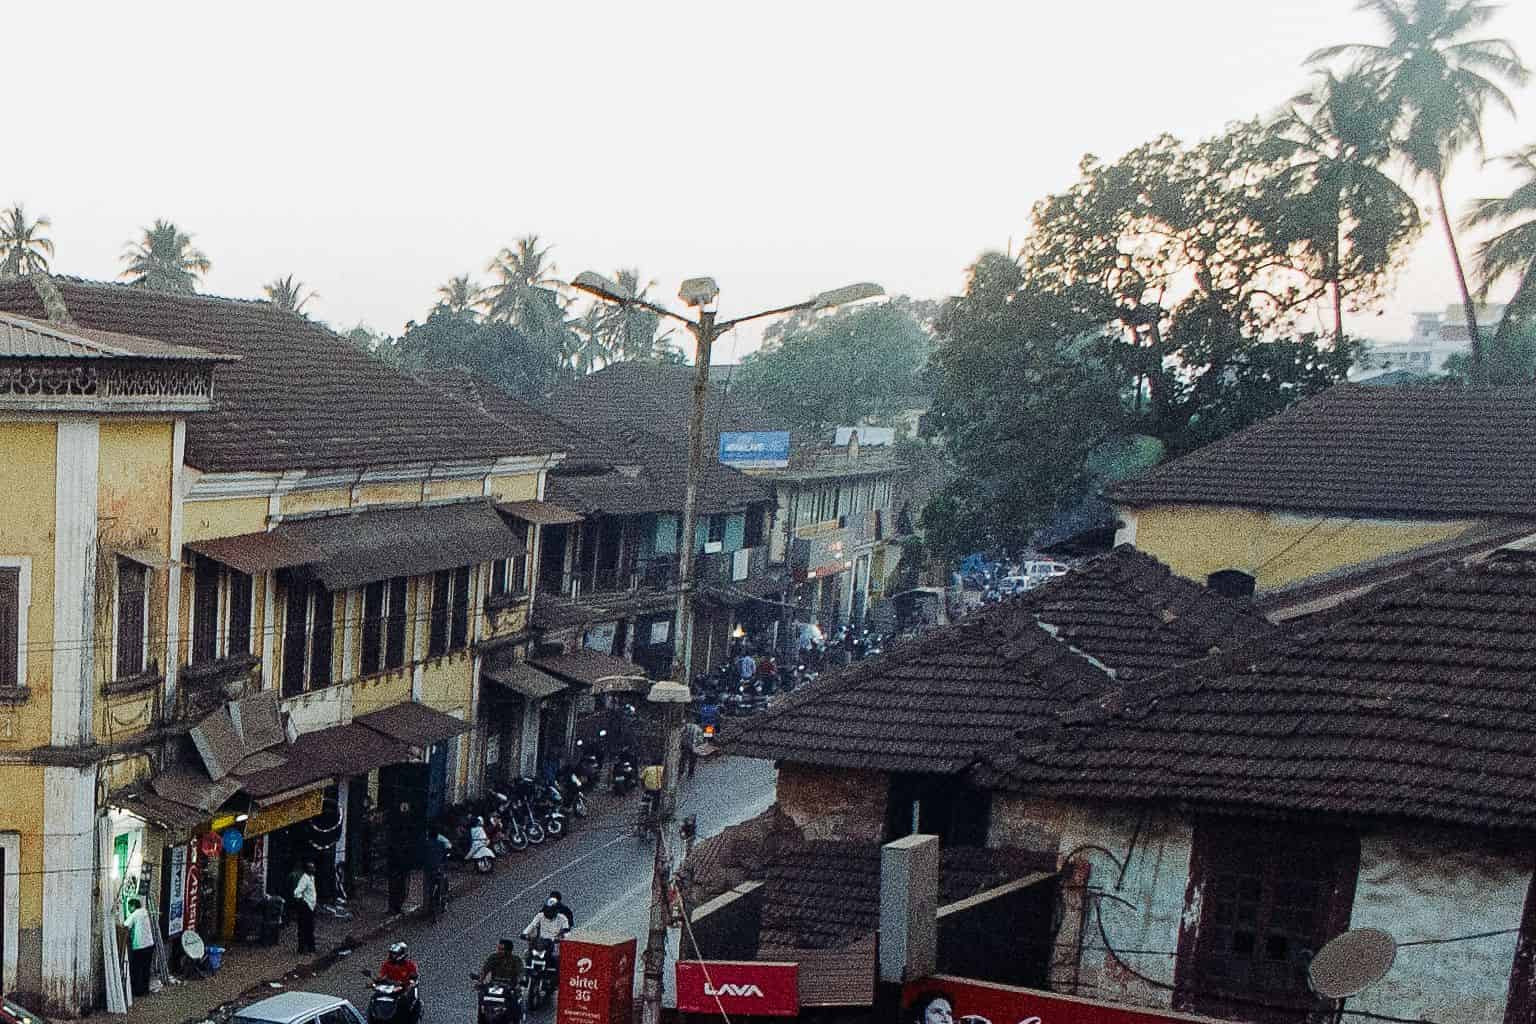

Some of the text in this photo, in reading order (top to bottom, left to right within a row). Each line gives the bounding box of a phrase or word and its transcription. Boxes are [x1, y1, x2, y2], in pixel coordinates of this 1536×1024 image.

[569, 975, 599, 991] airtel
[704, 982, 764, 998] LAVA
[575, 990, 592, 1002] 3G
